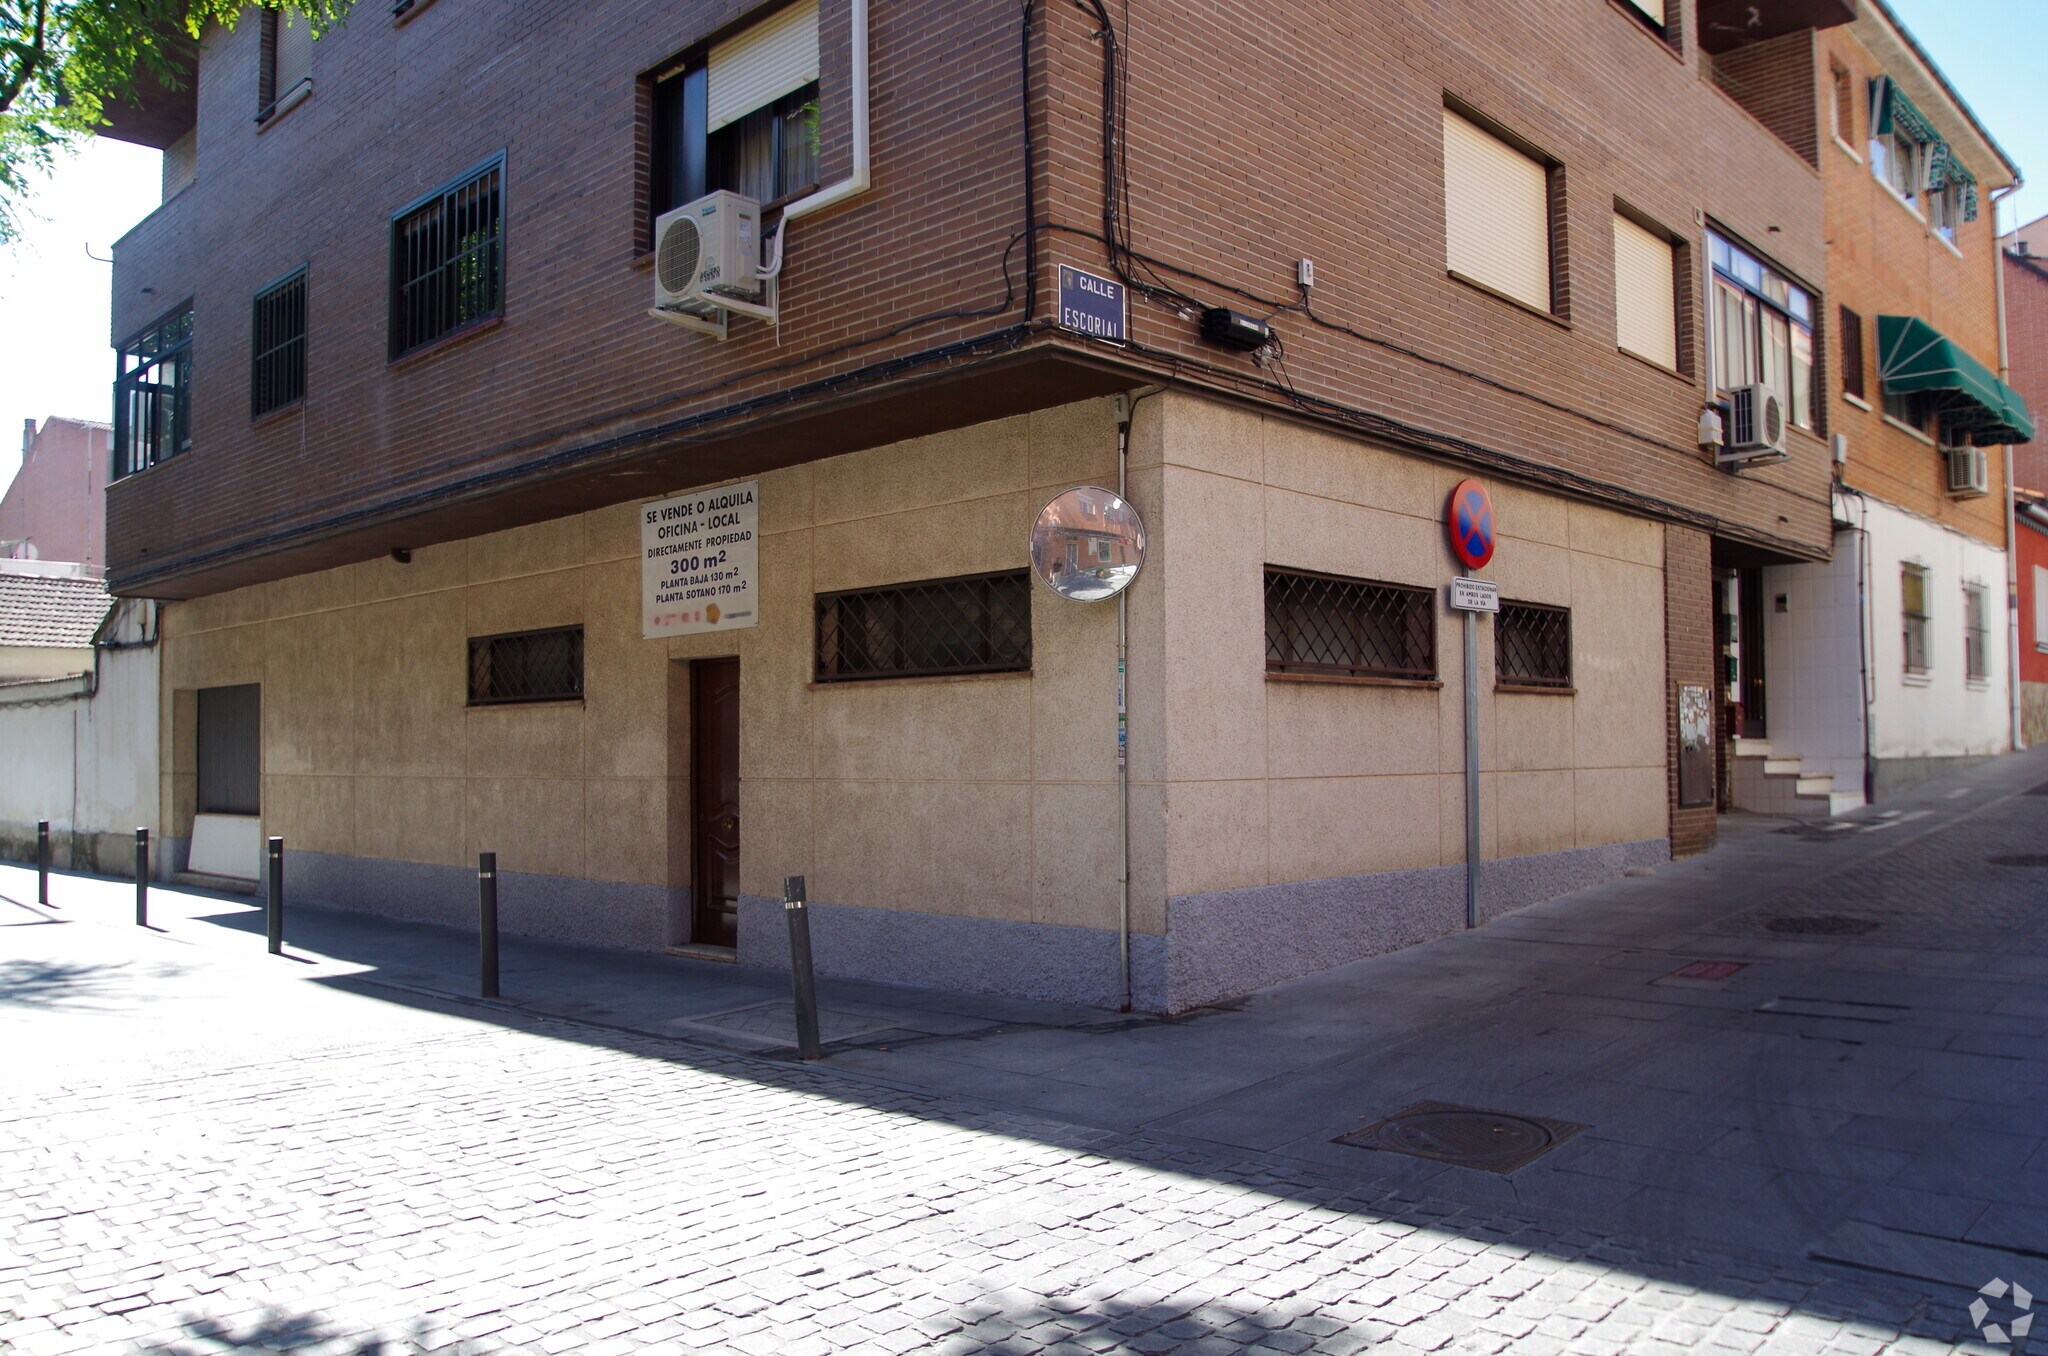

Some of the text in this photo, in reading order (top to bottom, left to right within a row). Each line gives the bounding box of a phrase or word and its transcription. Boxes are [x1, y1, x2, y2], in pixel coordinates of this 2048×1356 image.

[1080, 276, 1115, 300] CALLE
[646, 491, 754, 524] SE VENDE O ALQUILA
[658, 520, 698, 539] OFICINA
[708, 512, 741, 530] LOCAL
[647, 530, 752, 558] DIRECTAMENTE PROPIEDAD
[670, 556, 700, 575] 300
[660, 577, 689, 590] PLANTA
[690, 574, 709, 585] BAJA
[710, 571, 724, 582] 130
[656, 590, 684, 604] PLANTA
[686, 586, 716, 600] SOTANO
[718, 584, 731, 595] 170
